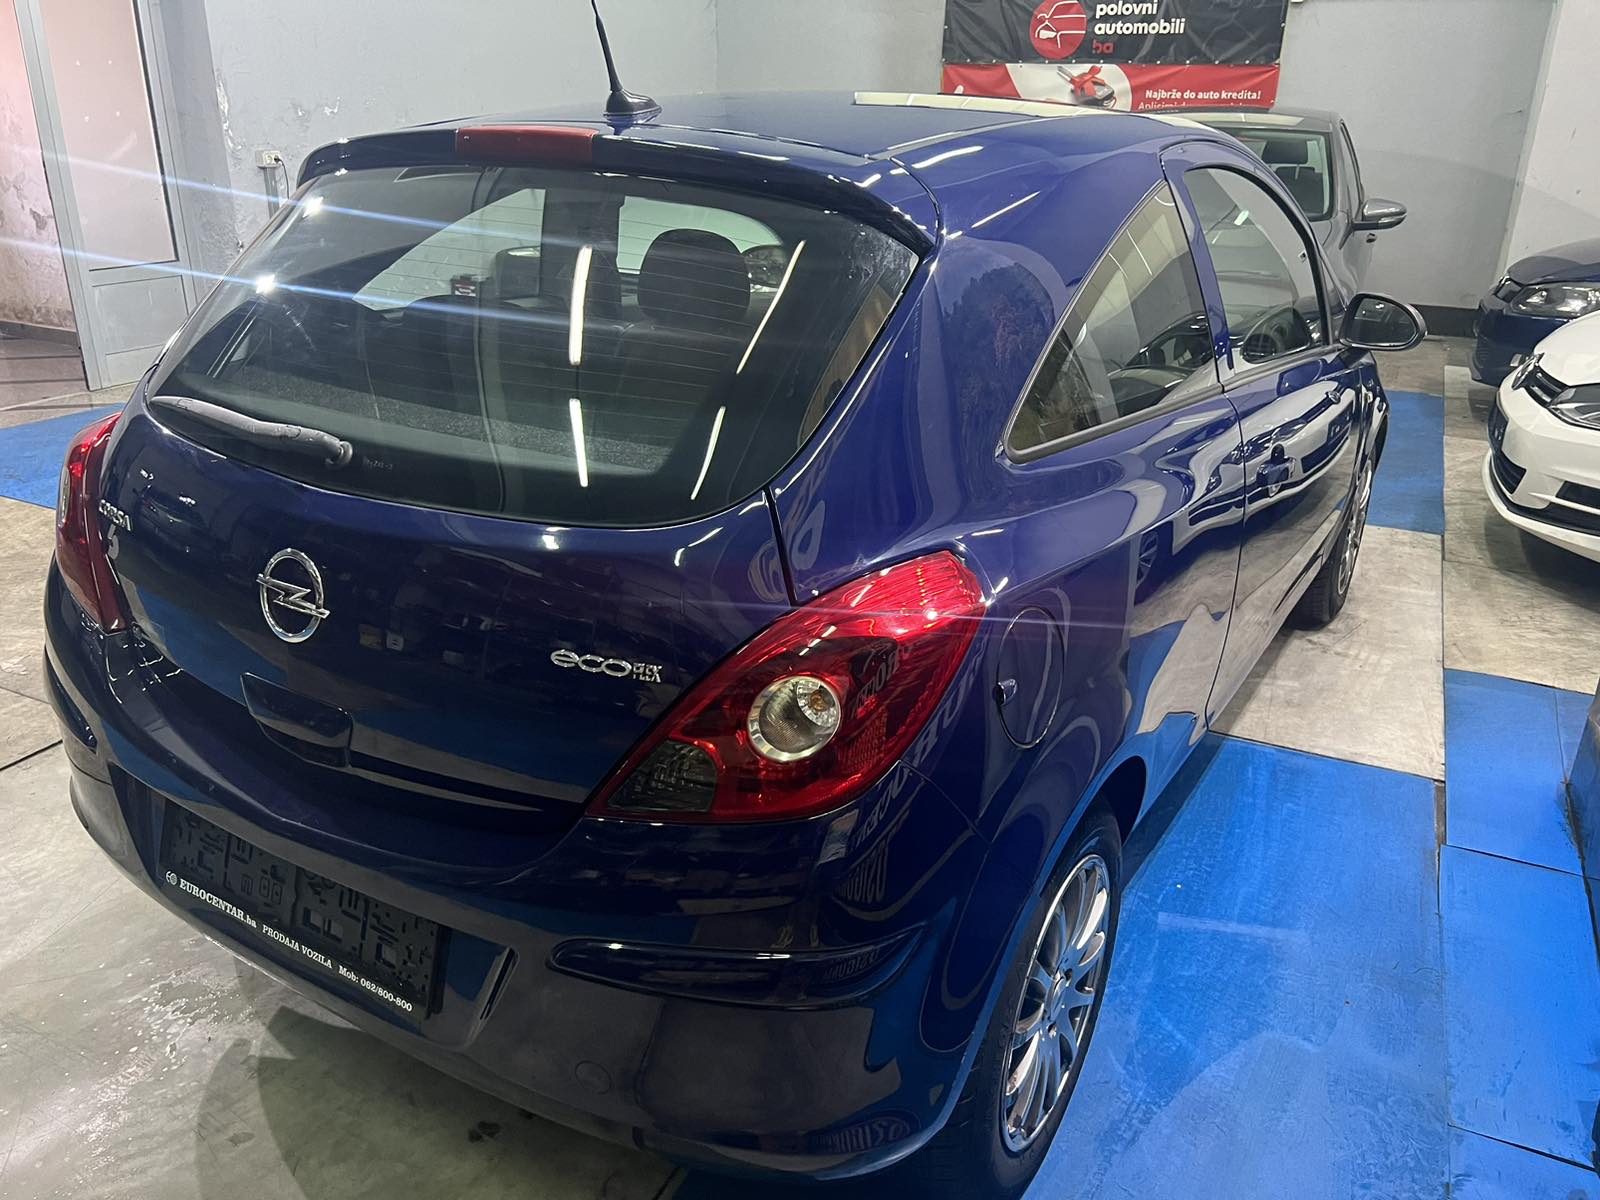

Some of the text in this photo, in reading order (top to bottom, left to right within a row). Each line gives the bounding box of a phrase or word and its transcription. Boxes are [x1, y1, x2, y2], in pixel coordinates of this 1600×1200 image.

[1095, 0, 1159, 19] polovni
[1094, 18, 1186, 35] automobili
[1145, 89, 1261, 101] Najbrže do auto kredita!
[180, 878, 413, 1012] EUROCENTAR.ba PRODAJA VOZILA Mob: 062/800-800
